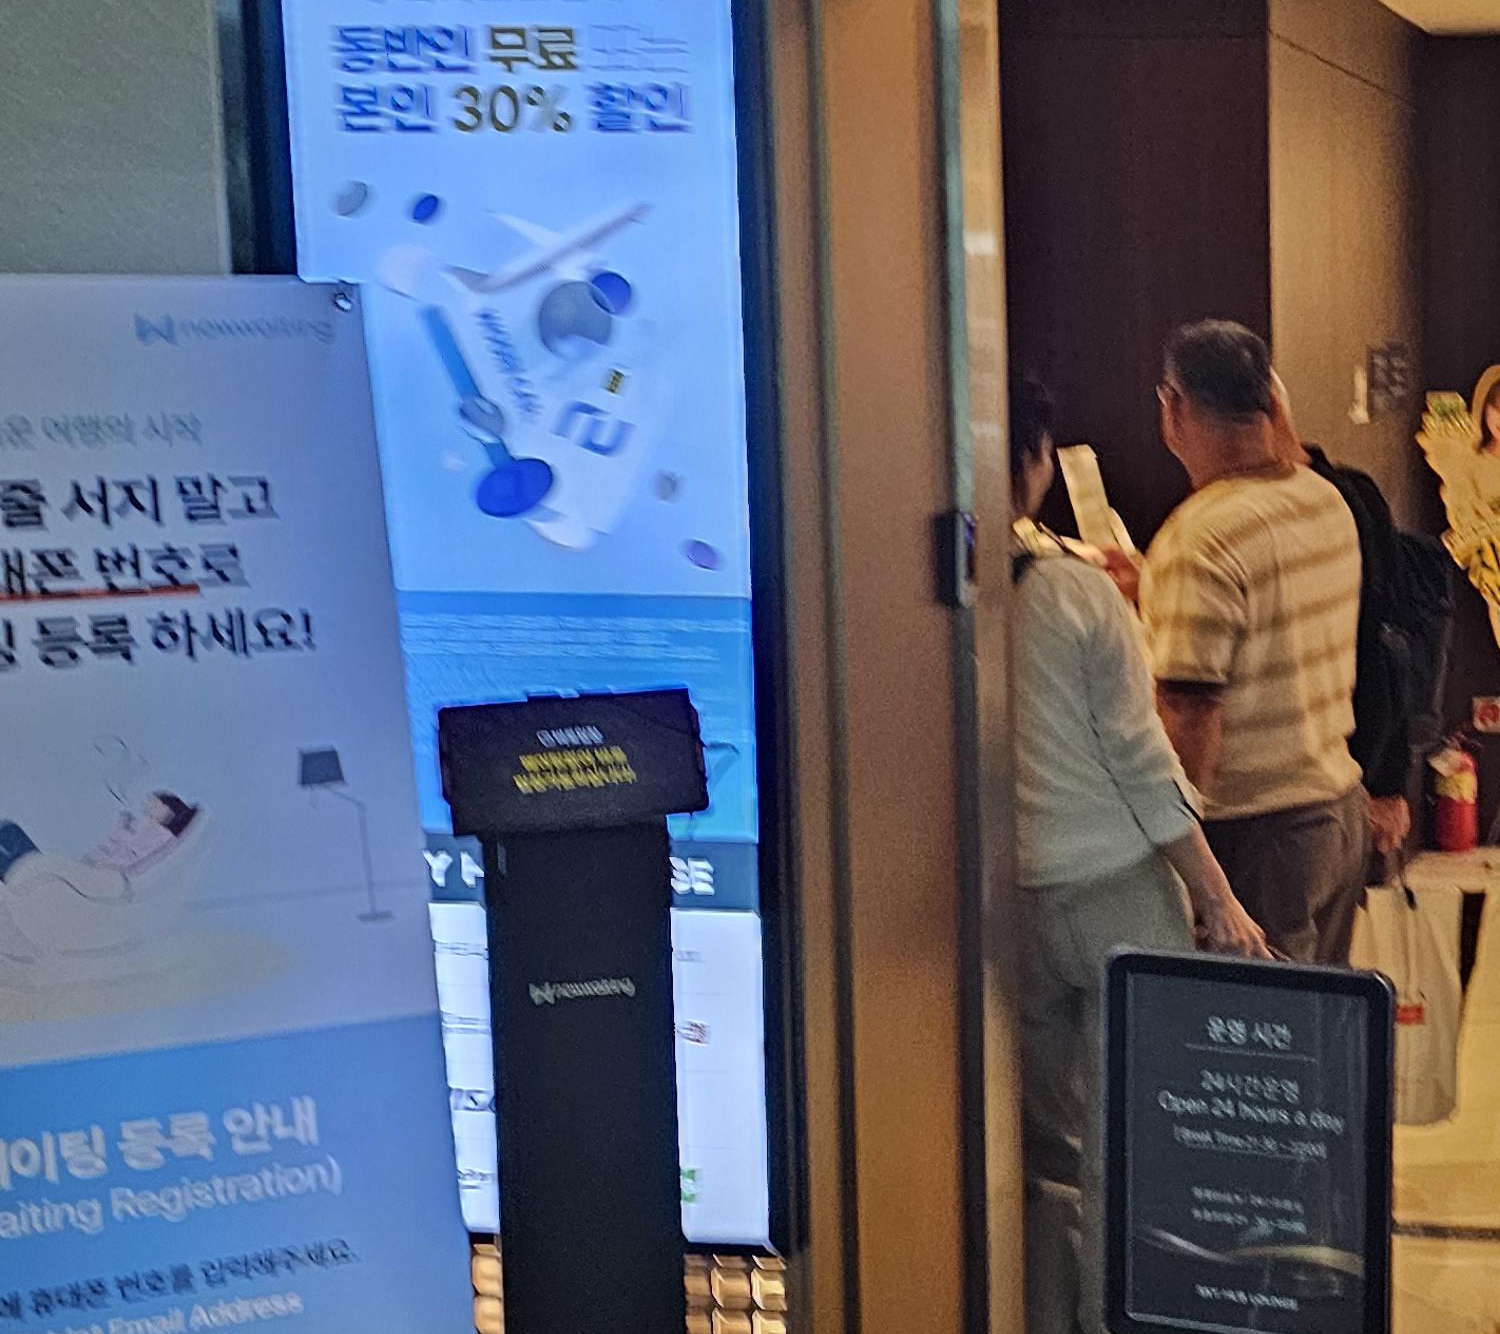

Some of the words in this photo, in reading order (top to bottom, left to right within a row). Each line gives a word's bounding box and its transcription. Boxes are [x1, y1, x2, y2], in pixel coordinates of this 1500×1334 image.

[490, 25, 579, 73] 무료
[337, 84, 435, 134] 본인
[454, 84, 573, 134] 30%
[61, 473, 166, 530] 서지
[172, 472, 281, 527] 말고
[93, 540, 252, 595] 번호로
[31, 612, 140, 669] 등록
[146, 606, 318, 661] 하세요!
[116, 1110, 218, 1171] 등록
[221, 1094, 321, 1157] 안내
[1157, 1090, 1211, 1117] Open
[1238, 1100, 1292, 1126] hours
[109, 1153, 345, 1224] Registration)
[188, 1290, 305, 1333] Address
